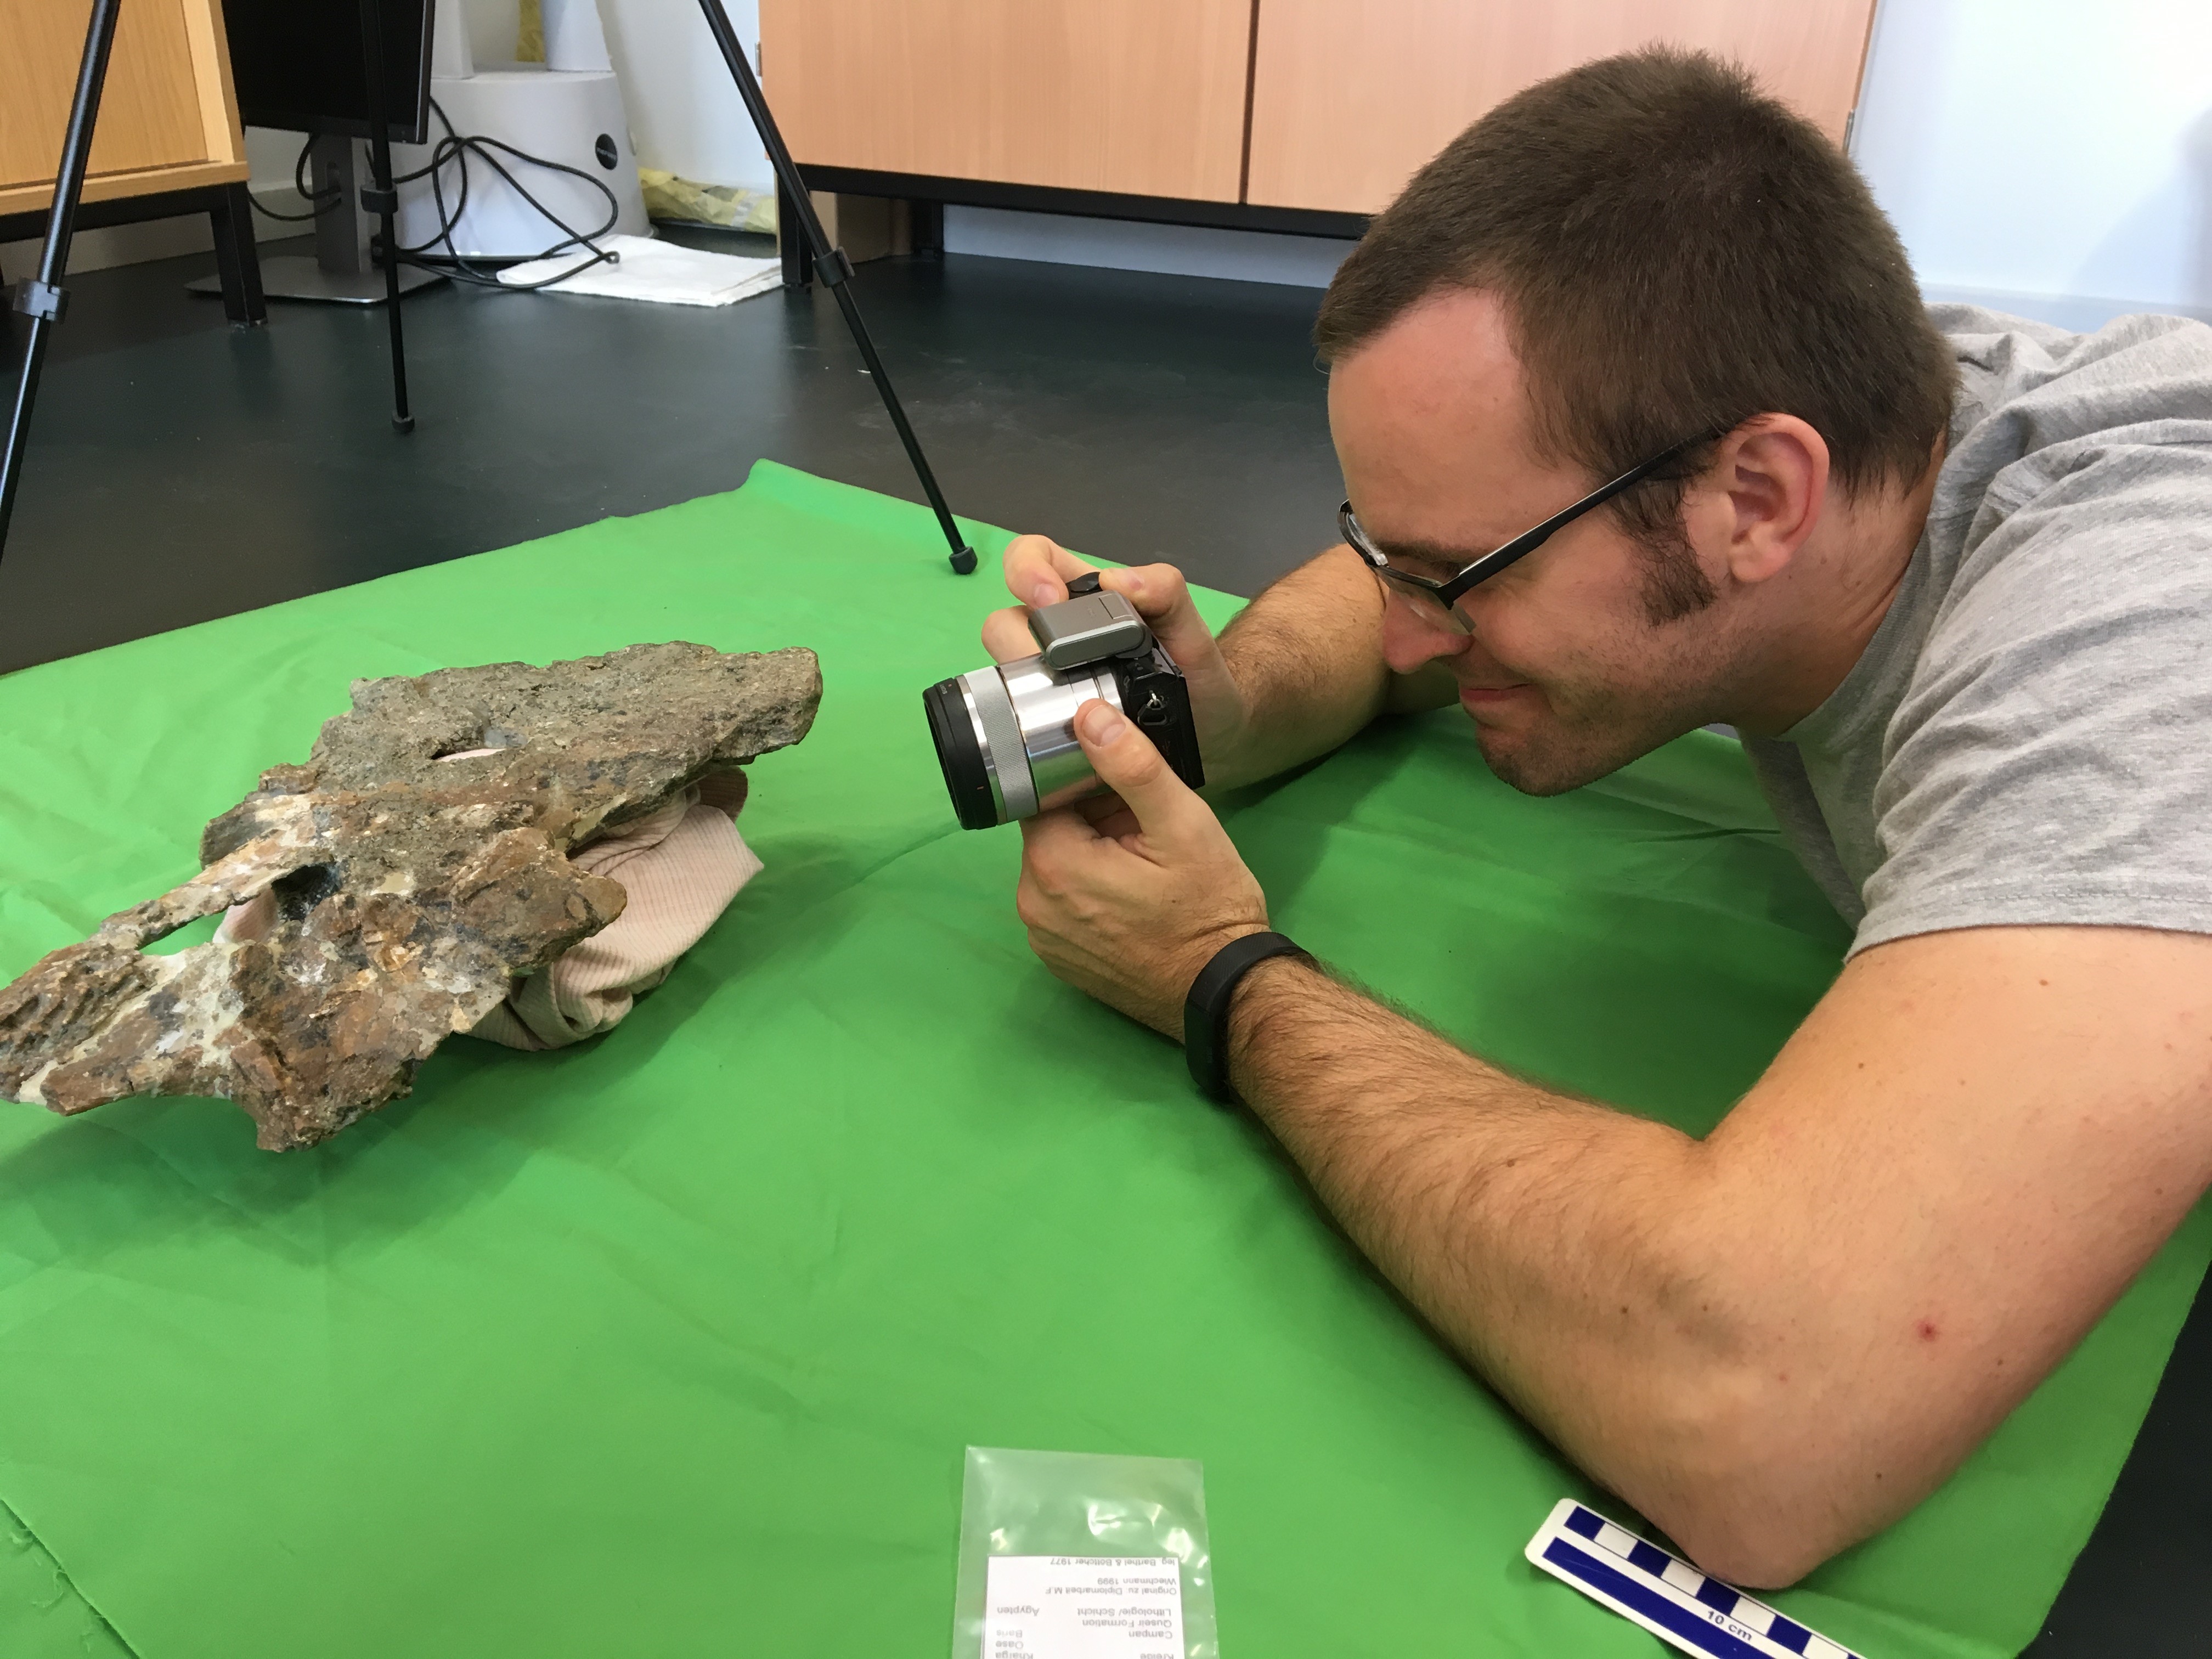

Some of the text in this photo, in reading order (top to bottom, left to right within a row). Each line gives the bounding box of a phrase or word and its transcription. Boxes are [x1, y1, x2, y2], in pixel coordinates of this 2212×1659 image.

[1065, 1587, 1122, 1595] Diplomarbeit
[1143, 1587, 1176, 1595] Original
[1076, 1607, 1171, 1617] Lithologie/ Schicht
[1082, 1620, 1172, 1628] Quseir Formation
[1708, 1611, 1752, 1641] 10 cm
[1128, 1630, 1172, 1640] Campan
[995, 1640, 1024, 1649] Oase
